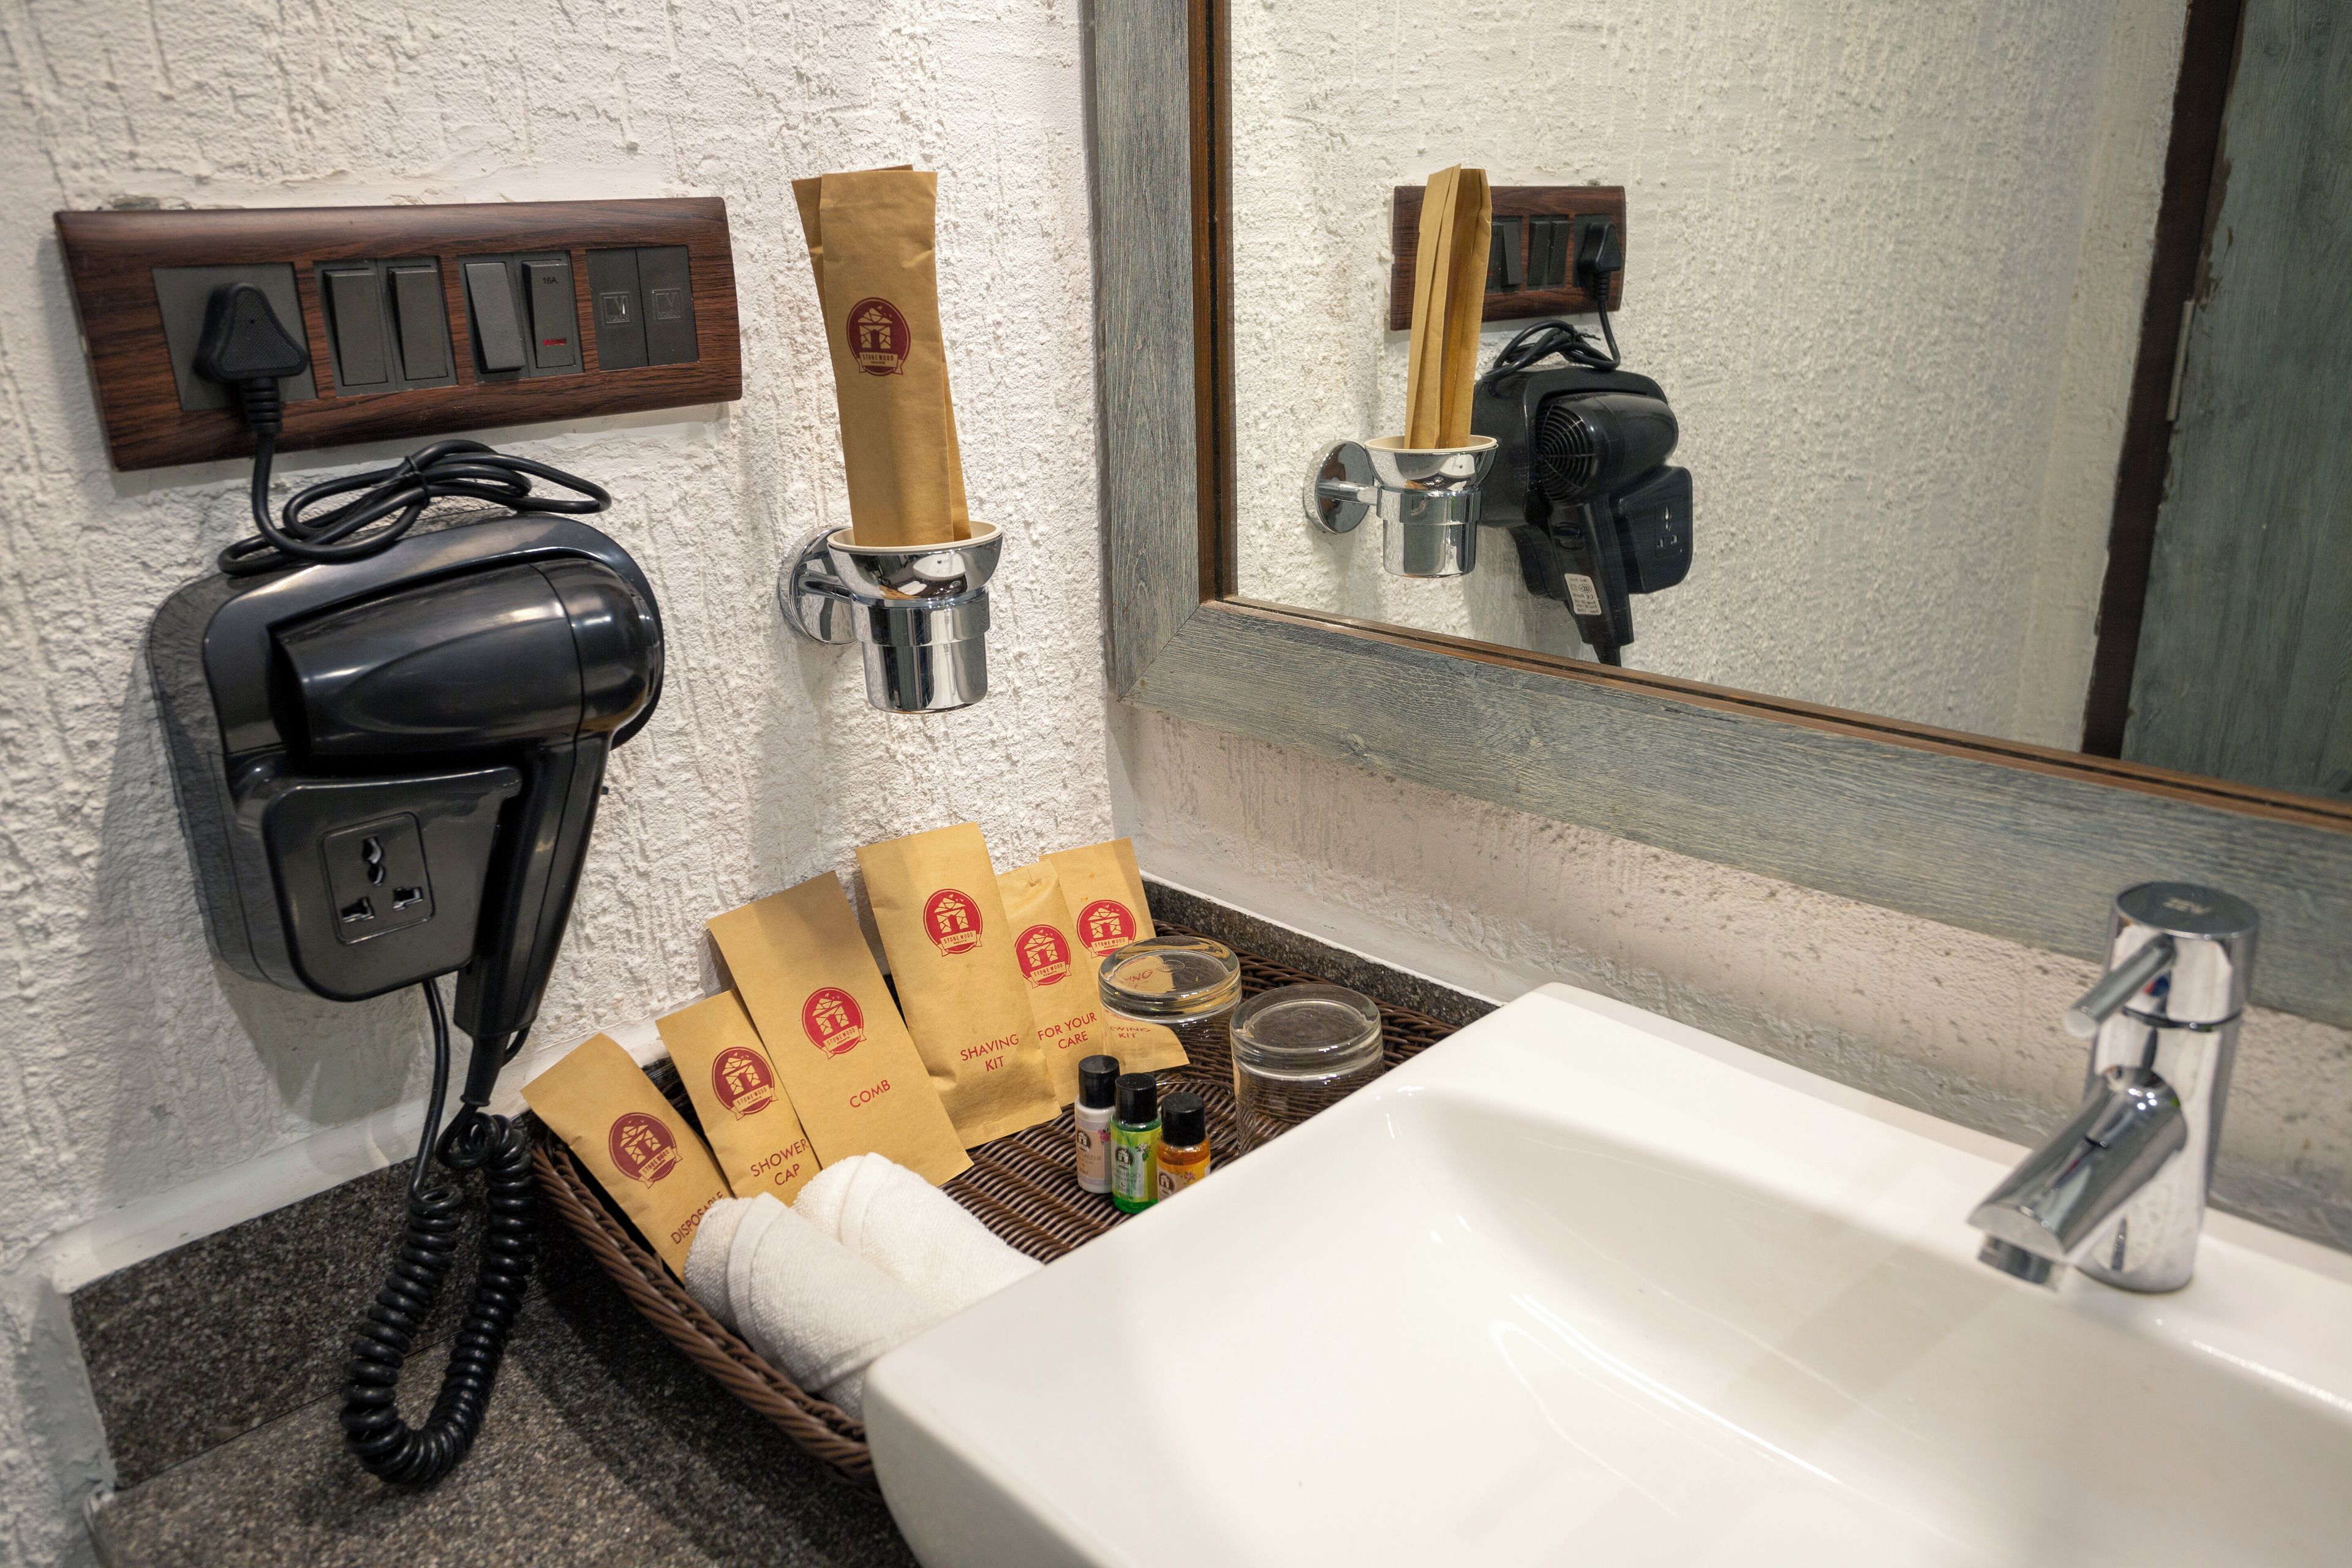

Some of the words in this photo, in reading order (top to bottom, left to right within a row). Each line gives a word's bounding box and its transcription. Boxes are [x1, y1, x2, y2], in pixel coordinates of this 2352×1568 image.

[1037, 1025, 1063, 1041] FOR
[1064, 1012, 1097, 1031] YOUR
[1058, 1031, 1088, 1049] CARE
[960, 1034, 1019, 1061] SHAVING
[985, 1055, 1004, 1072] KIT
[850, 1079, 891, 1107] COMB
[750, 1138, 810, 1177] SHOWER
[774, 1163, 800, 1186] CAP
